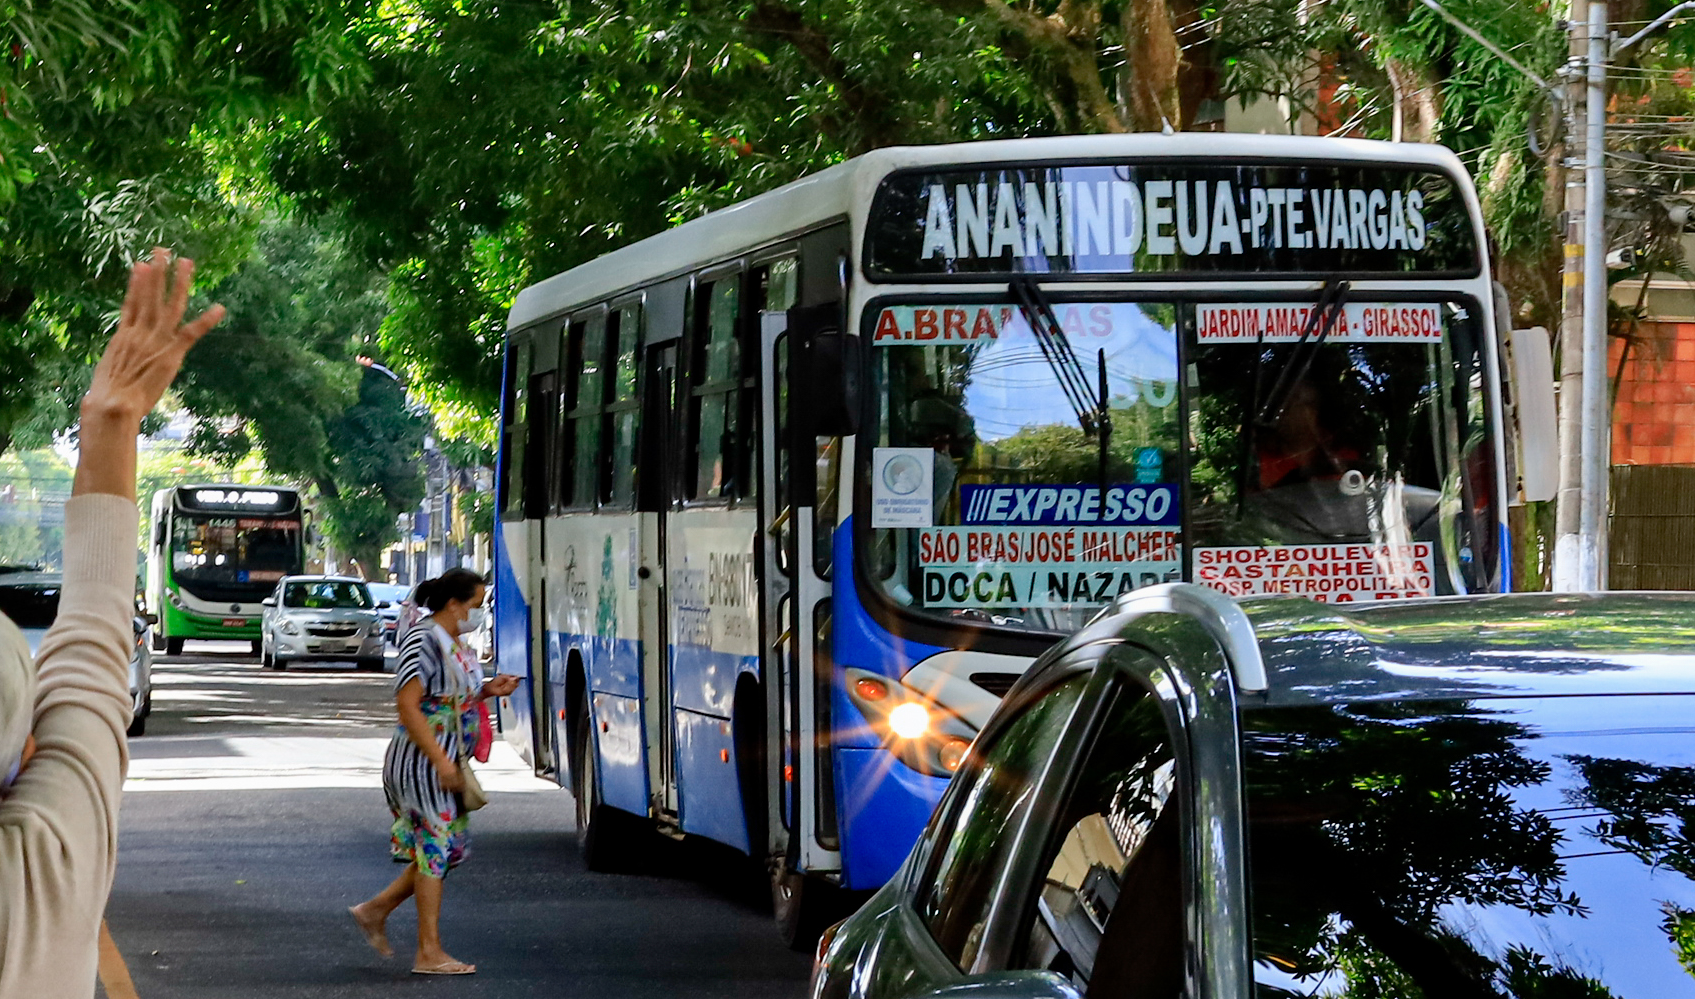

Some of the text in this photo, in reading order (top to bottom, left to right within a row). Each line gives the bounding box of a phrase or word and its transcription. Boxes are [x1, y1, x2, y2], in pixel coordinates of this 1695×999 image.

[1200, 308, 1260, 338] JARDIM
[1363, 308, 1441, 338] GIRASSOL
[920, 529, 960, 563] SÃO
[1082, 531, 1177, 562] MALCHER
[1199, 560, 1429, 579] CASTANHEIRA
[1263, 575, 1430, 593] METROPOLITANO
[925, 571, 1017, 603] DOCA
